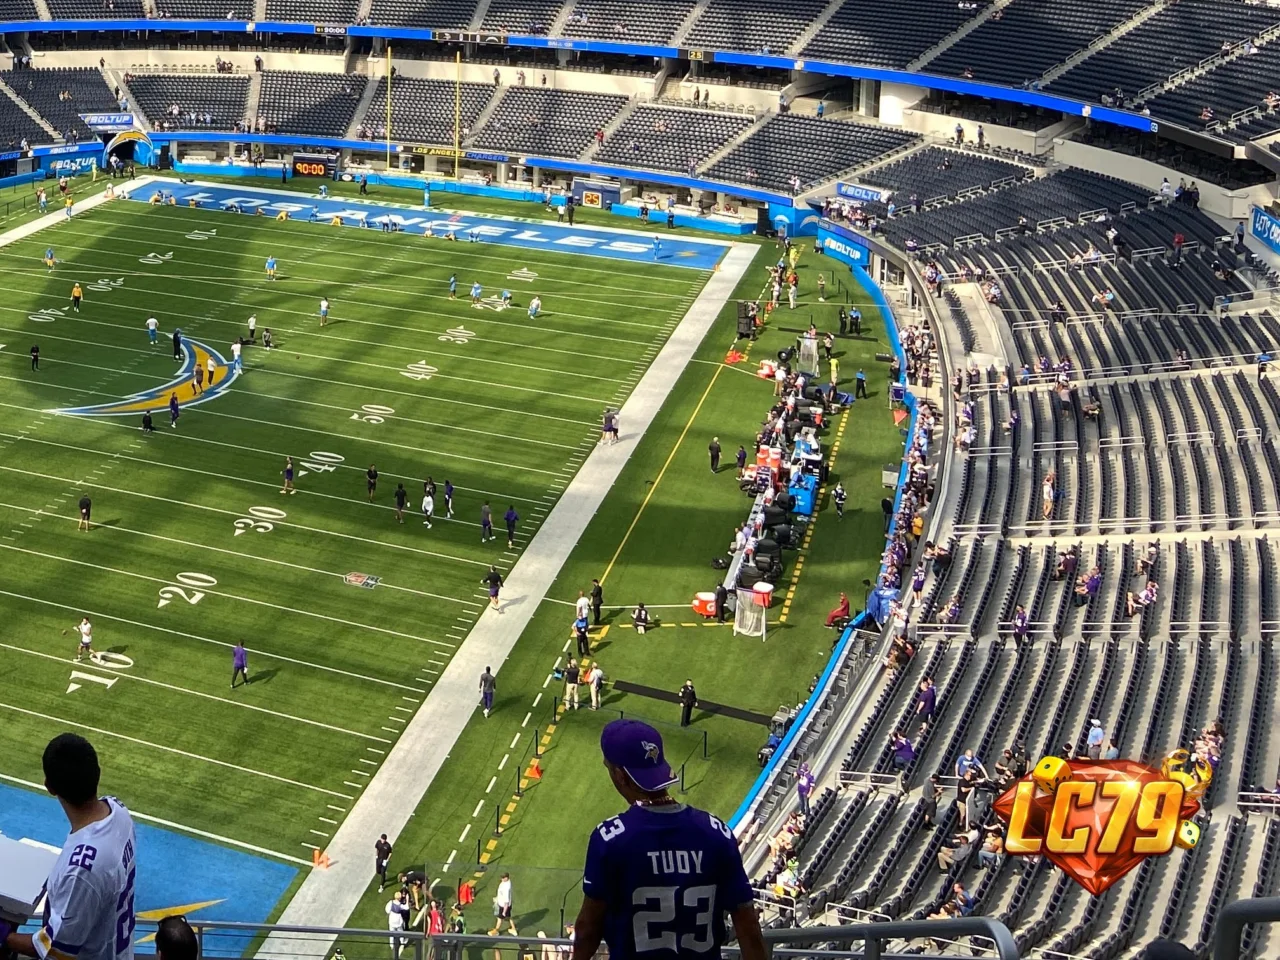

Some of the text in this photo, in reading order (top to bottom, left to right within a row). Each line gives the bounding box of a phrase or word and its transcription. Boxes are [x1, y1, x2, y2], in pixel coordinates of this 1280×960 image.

[690, 51, 701, 59] 25
[430, 149, 466, 158] ANGELES
[467, 152, 509, 162] CHARGERS
[296, 162, 325, 175] 90:00
[586, 194, 598, 204] 25
[185, 192, 654, 254] LOS ANGELES
[825, 238, 861, 260] #BOLTUP
[86, 278, 124, 292] 30
[28, 306, 66, 322] 40
[438, 328, 476, 344] 30
[399, 364, 438, 380] 40
[349, 404, 395, 424] 50
[300, 452, 345, 473] 40
[233, 506, 287, 534] 30
[158, 572, 217, 605] 20
[69, 651, 134, 689] 10
[68, 844, 97, 872] 22
[647, 850, 703, 874] TUDY
[632, 884, 717, 954] 23
